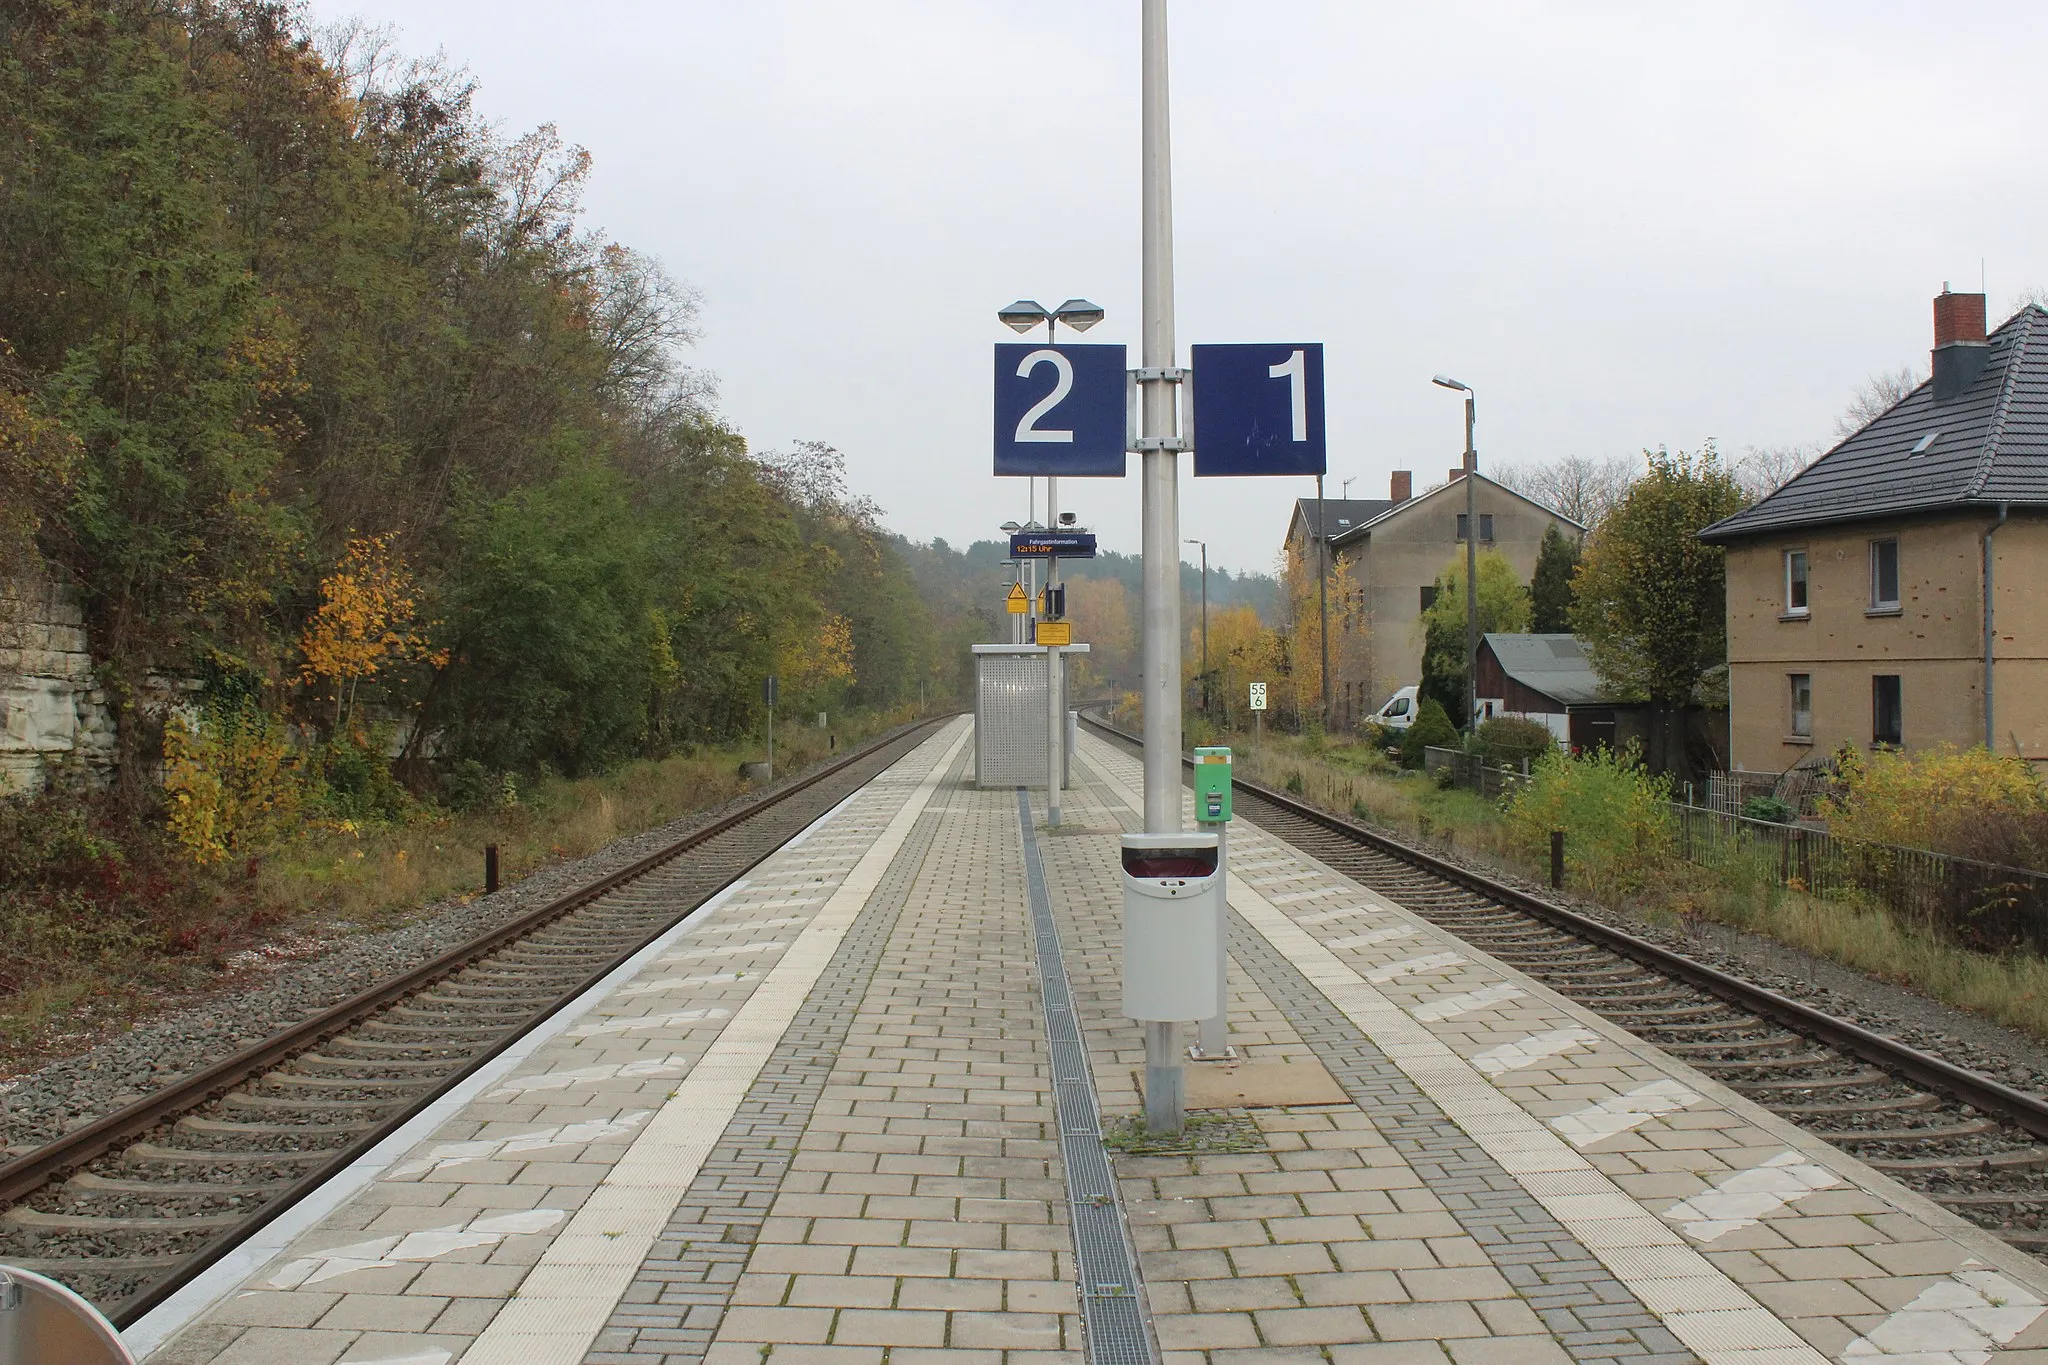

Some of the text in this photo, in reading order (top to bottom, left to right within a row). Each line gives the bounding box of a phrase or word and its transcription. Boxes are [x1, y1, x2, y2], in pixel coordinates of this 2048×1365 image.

[1014, 349, 1074, 443] 2
[1269, 350, 1307, 442] 1
[1016, 545, 1052, 553] 12:15 Uhr
[1251, 684, 1266, 695] 55
[1255, 696, 1263, 707] 6
